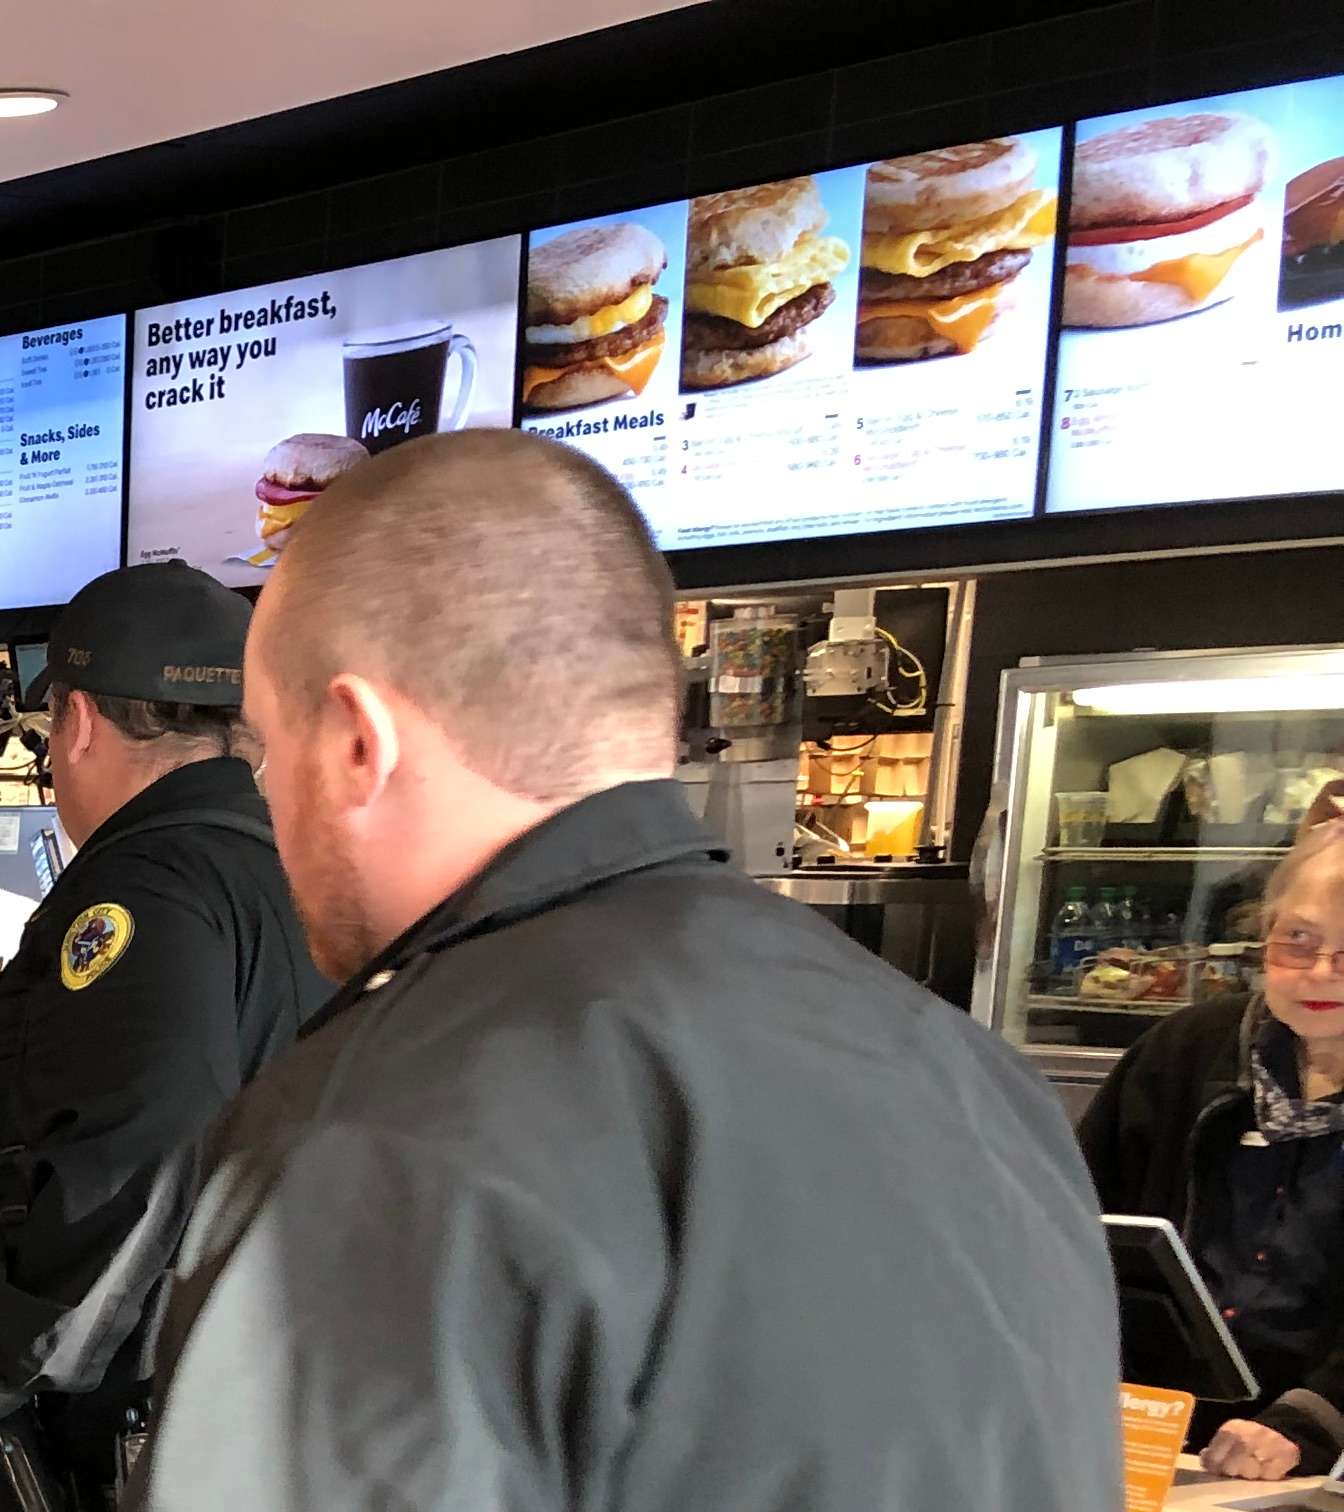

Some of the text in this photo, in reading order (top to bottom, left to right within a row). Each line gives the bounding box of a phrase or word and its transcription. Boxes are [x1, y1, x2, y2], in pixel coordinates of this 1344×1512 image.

[147, 290, 337, 347] Better breakfast,
[22, 328, 83, 349] Beverages
[146, 356, 183, 380] any
[189, 345, 230, 372] way
[236, 335, 277, 368] you
[145, 374, 225, 410] crack it
[614, 410, 665, 431] Meals
[20, 424, 100, 447] Snacks, Sides
[20, 452, 28, 465] &
[31, 450, 61, 463] More
[163, 665, 242, 684] PAQUETTE
